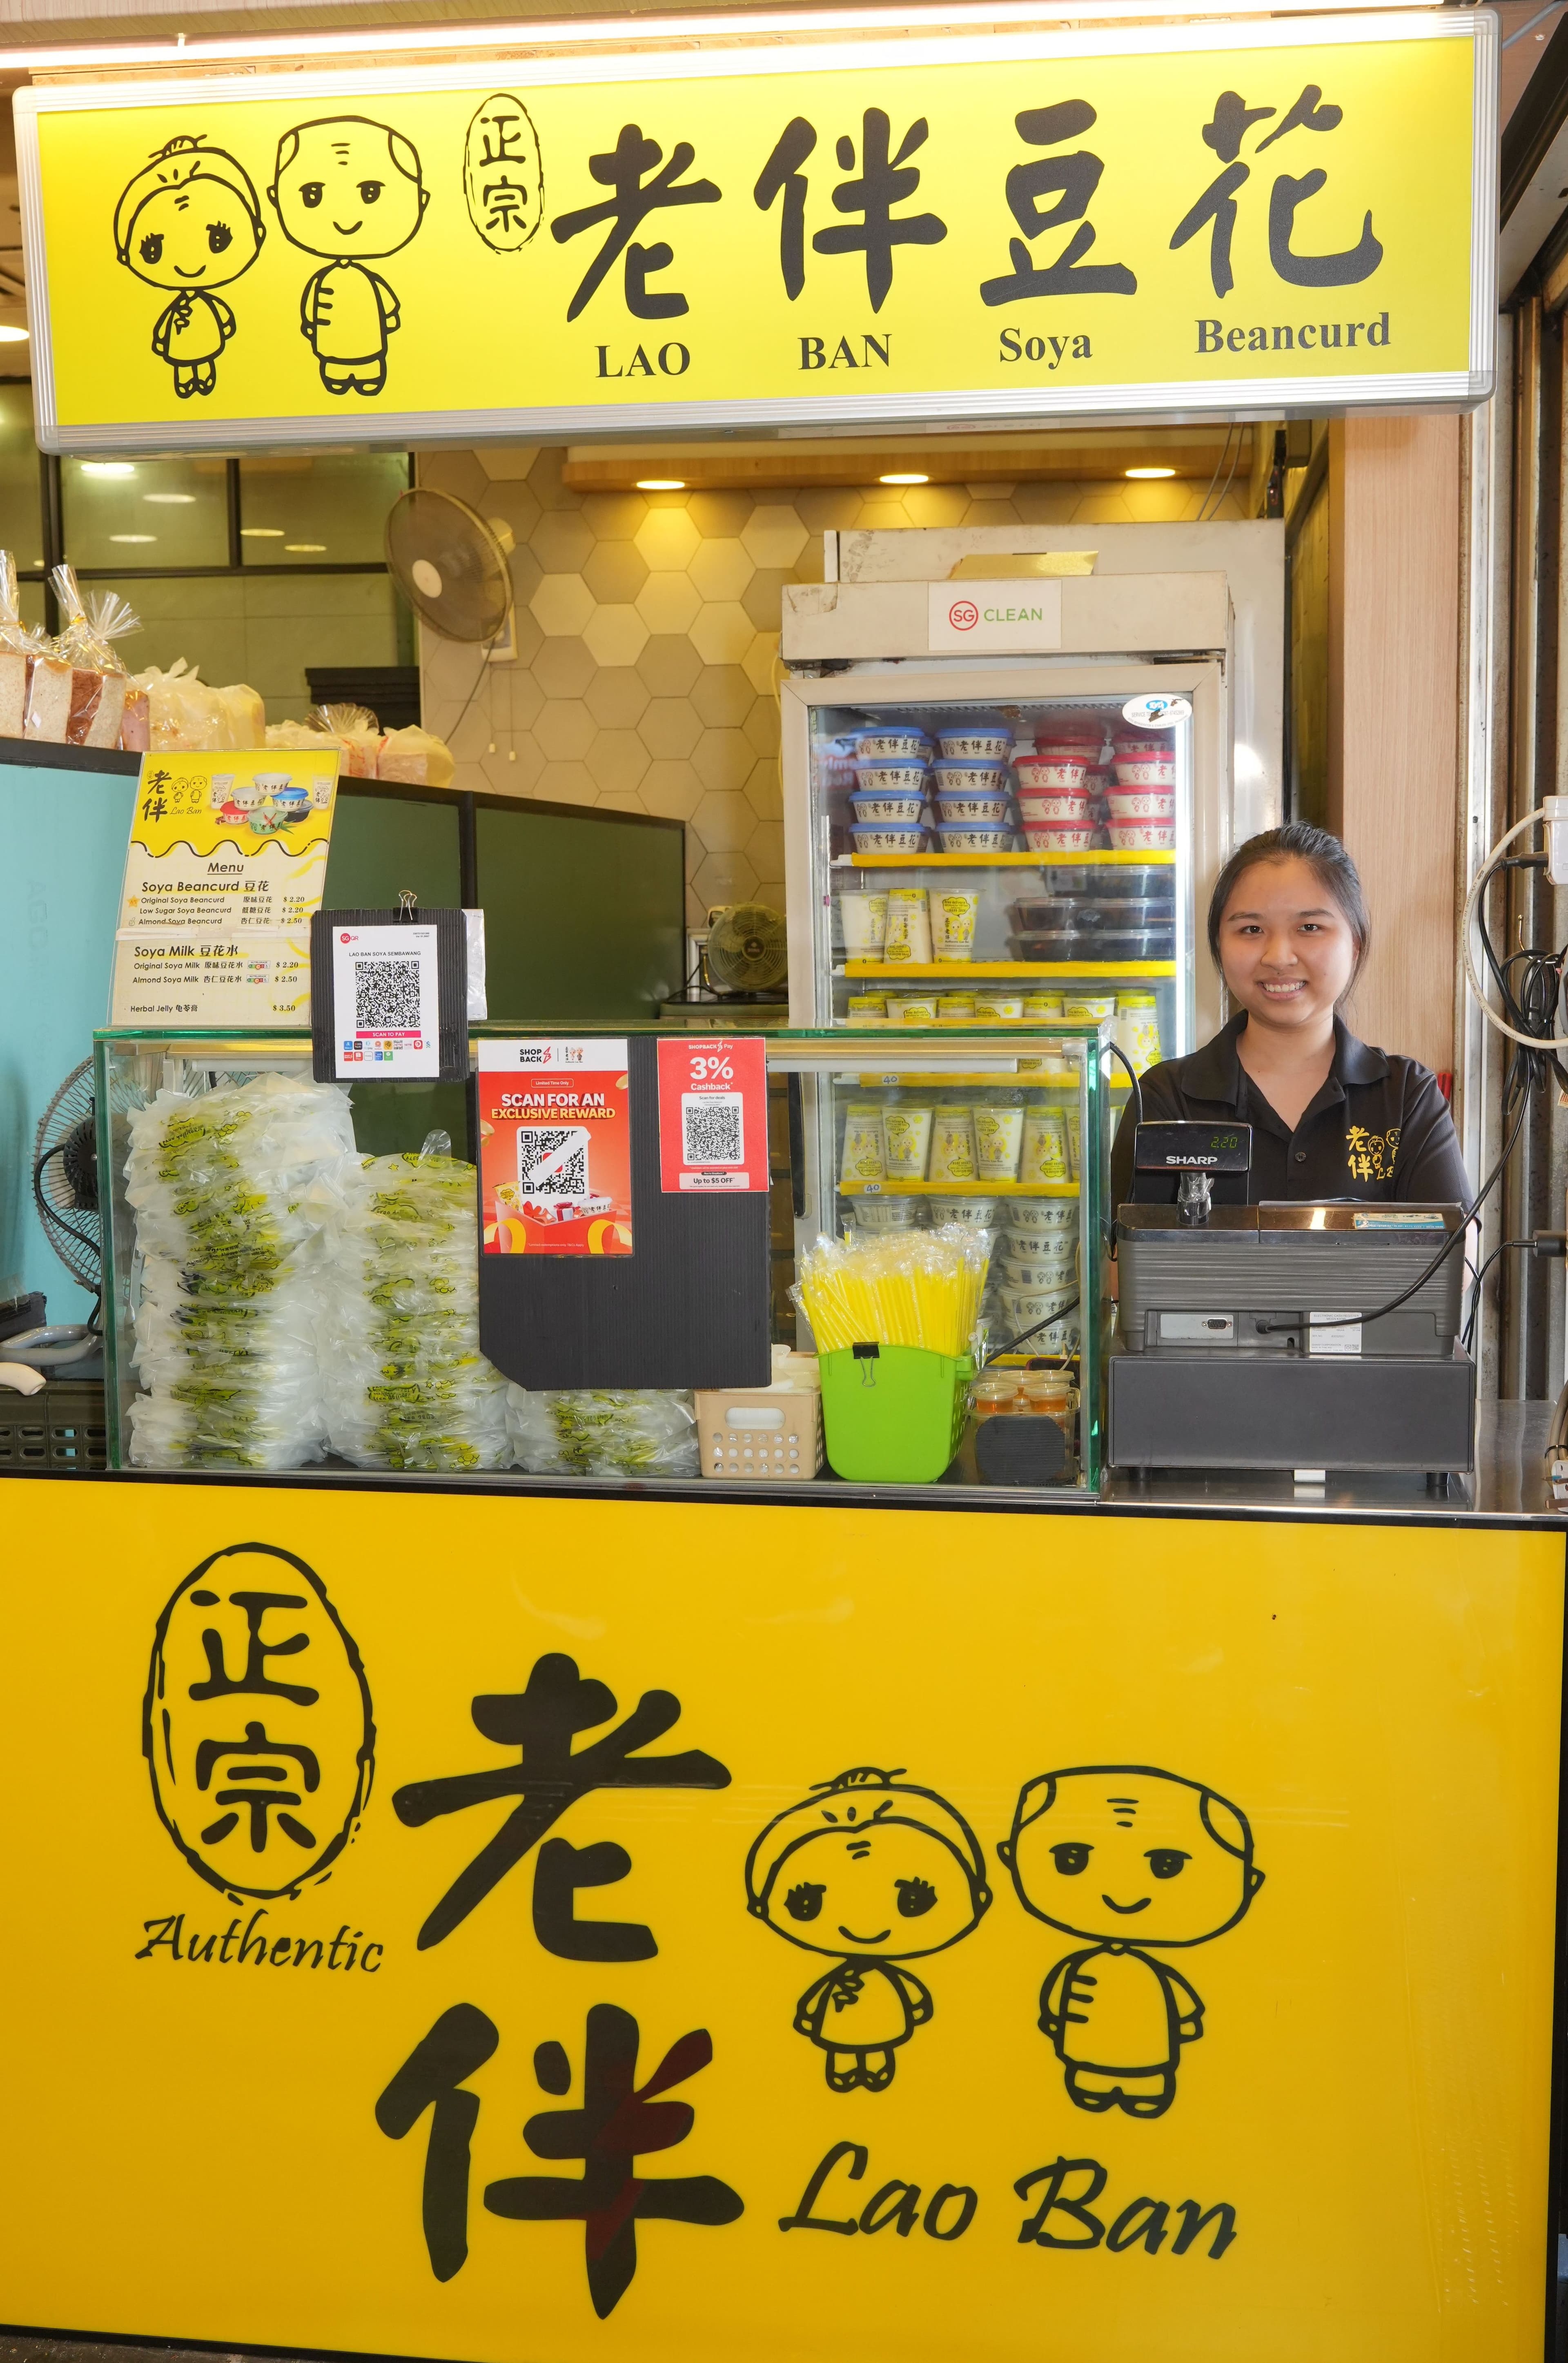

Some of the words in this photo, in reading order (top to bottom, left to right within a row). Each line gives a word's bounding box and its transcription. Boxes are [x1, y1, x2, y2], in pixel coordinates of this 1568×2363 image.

[479, 115, 527, 234] 正宗
[551, 85, 1383, 323] 老伴豆花
[597, 343, 690, 378] LAO
[799, 334, 892, 371] BAN
[999, 328, 1093, 371] Soya
[1195, 312, 1390, 353] Beancurd
[953, 610, 975, 622] SG
[984, 608, 1042, 621] CLEAN
[876, 739, 917, 751] 老伴豆花
[960, 740, 1002, 751] 老伴豆花
[878, 771, 920, 782] 老伴豆花
[143, 770, 172, 823] 老伴
[871, 802, 915, 813] 老伴豆花
[956, 802, 1000, 813] 老伴豆花
[873, 834, 916, 845] 老伴豆花
[207, 862, 244, 872] Menu
[142, 882, 173, 894] Soya
[177, 881, 239, 891] Beancurd
[243, 880, 270, 892] 豆花
[134, 946, 165, 959] Soya
[169, 946, 195, 956] Milk
[199, 944, 238, 957] 豆花水
[134, 962, 163, 971] Original
[690, 1056, 734, 1080] 3%
[884, 1076, 898, 1085] 40
[501, 1093, 545, 1107] SCAN
[548, 1093, 579, 1107] FOR
[580, 1092, 605, 1107] AN
[491, 1108, 558, 1120] EXCLUSIVE
[559, 1107, 616, 1120] REWARD
[1211, 1137, 1238, 1148] 2.20
[1166, 1156, 1218, 1164] SHARP
[1346, 1126, 1374, 1182] 老伴
[866, 1184, 880, 1192] 40
[950, 1208, 991, 1220] 老伴豆花
[1018, 1241, 1063, 1252] 老伴豆花
[189, 1591, 320, 1853] 正宗
[135, 1908, 383, 1972] Authentic
[375, 1652, 745, 2320] 老伴
[777, 2140, 979, 2241] Lao
[1013, 2155, 1239, 2260] Ban
